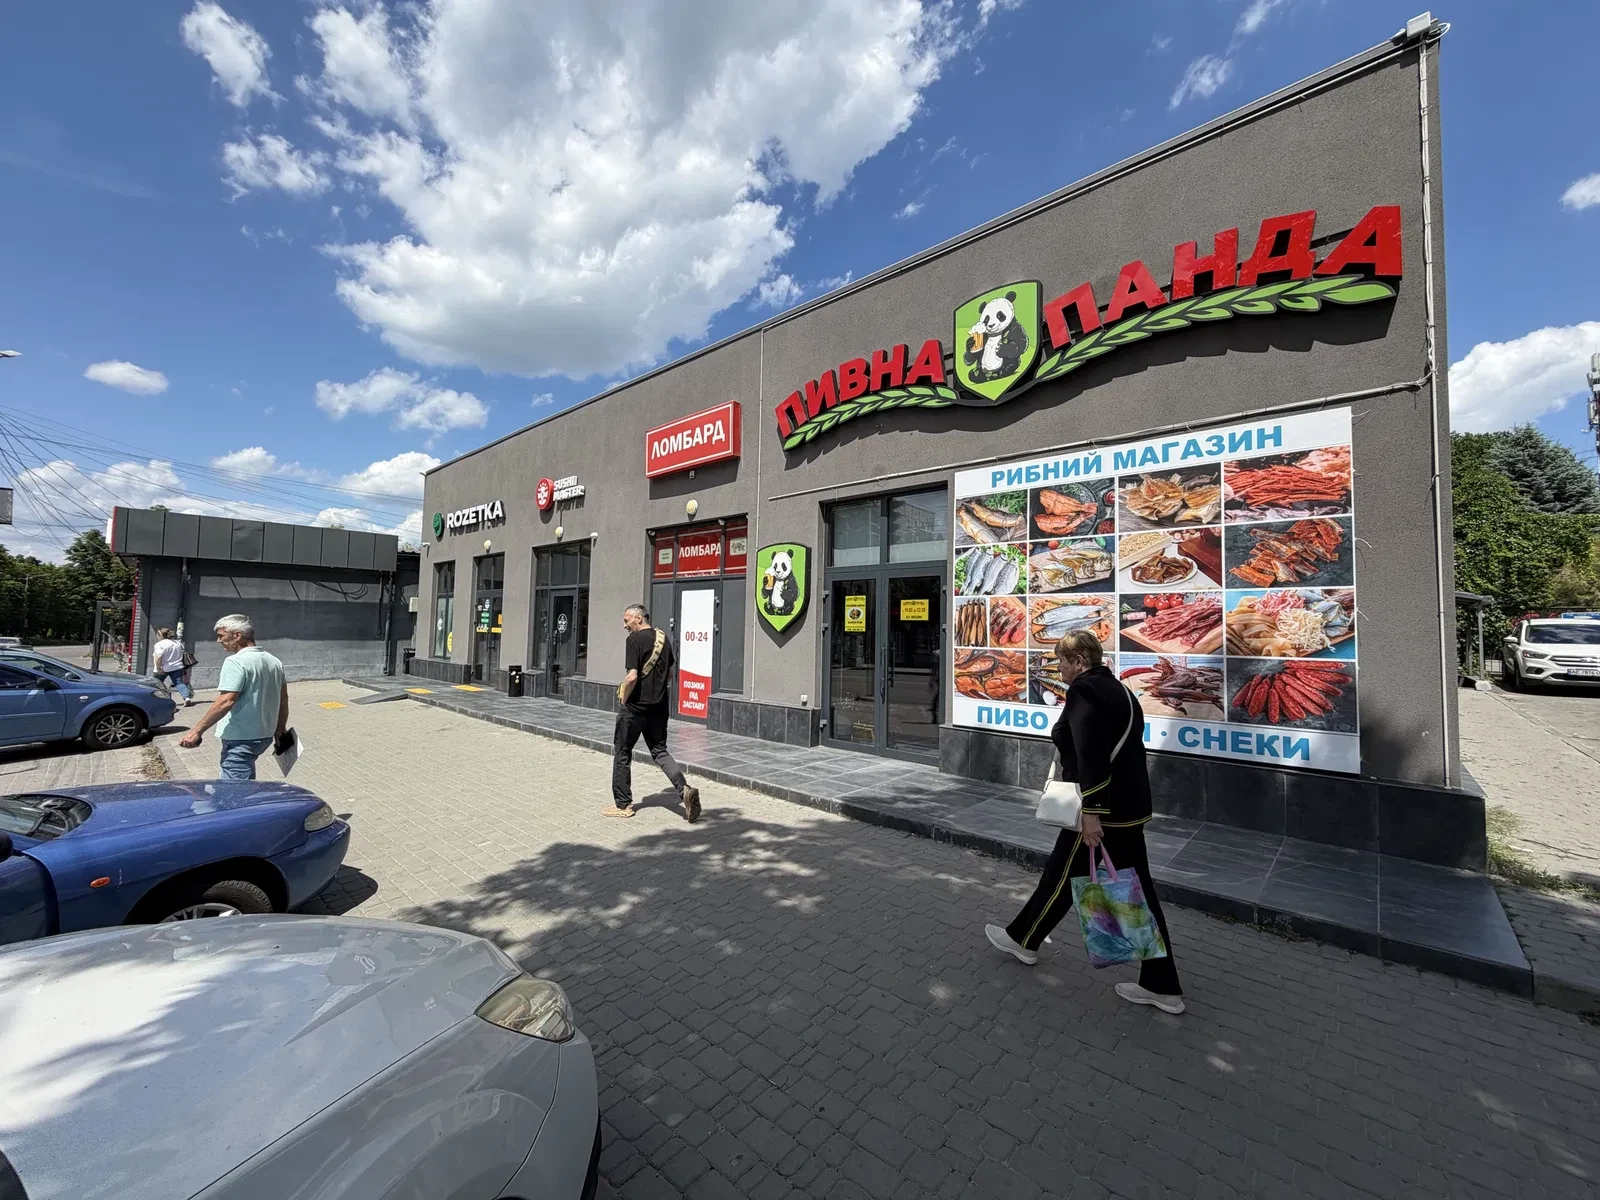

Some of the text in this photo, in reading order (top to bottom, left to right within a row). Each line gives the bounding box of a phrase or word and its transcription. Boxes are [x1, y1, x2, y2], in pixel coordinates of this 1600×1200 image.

[774, 205, 1403, 439] ПИВНА ПАНДА
[651, 420, 726, 460] ЛОМБАРД
[991, 425, 1283, 488] РИБНИЙ МАГАЗИН
[446, 500, 504, 528] ROZETKA
[678, 542, 721, 558] ЛОМБАРД
[685, 631, 708, 642] 00-24
[977, 706, 1048, 730] ПИВО
[1177, 726, 1310, 761] СНЕКИ
